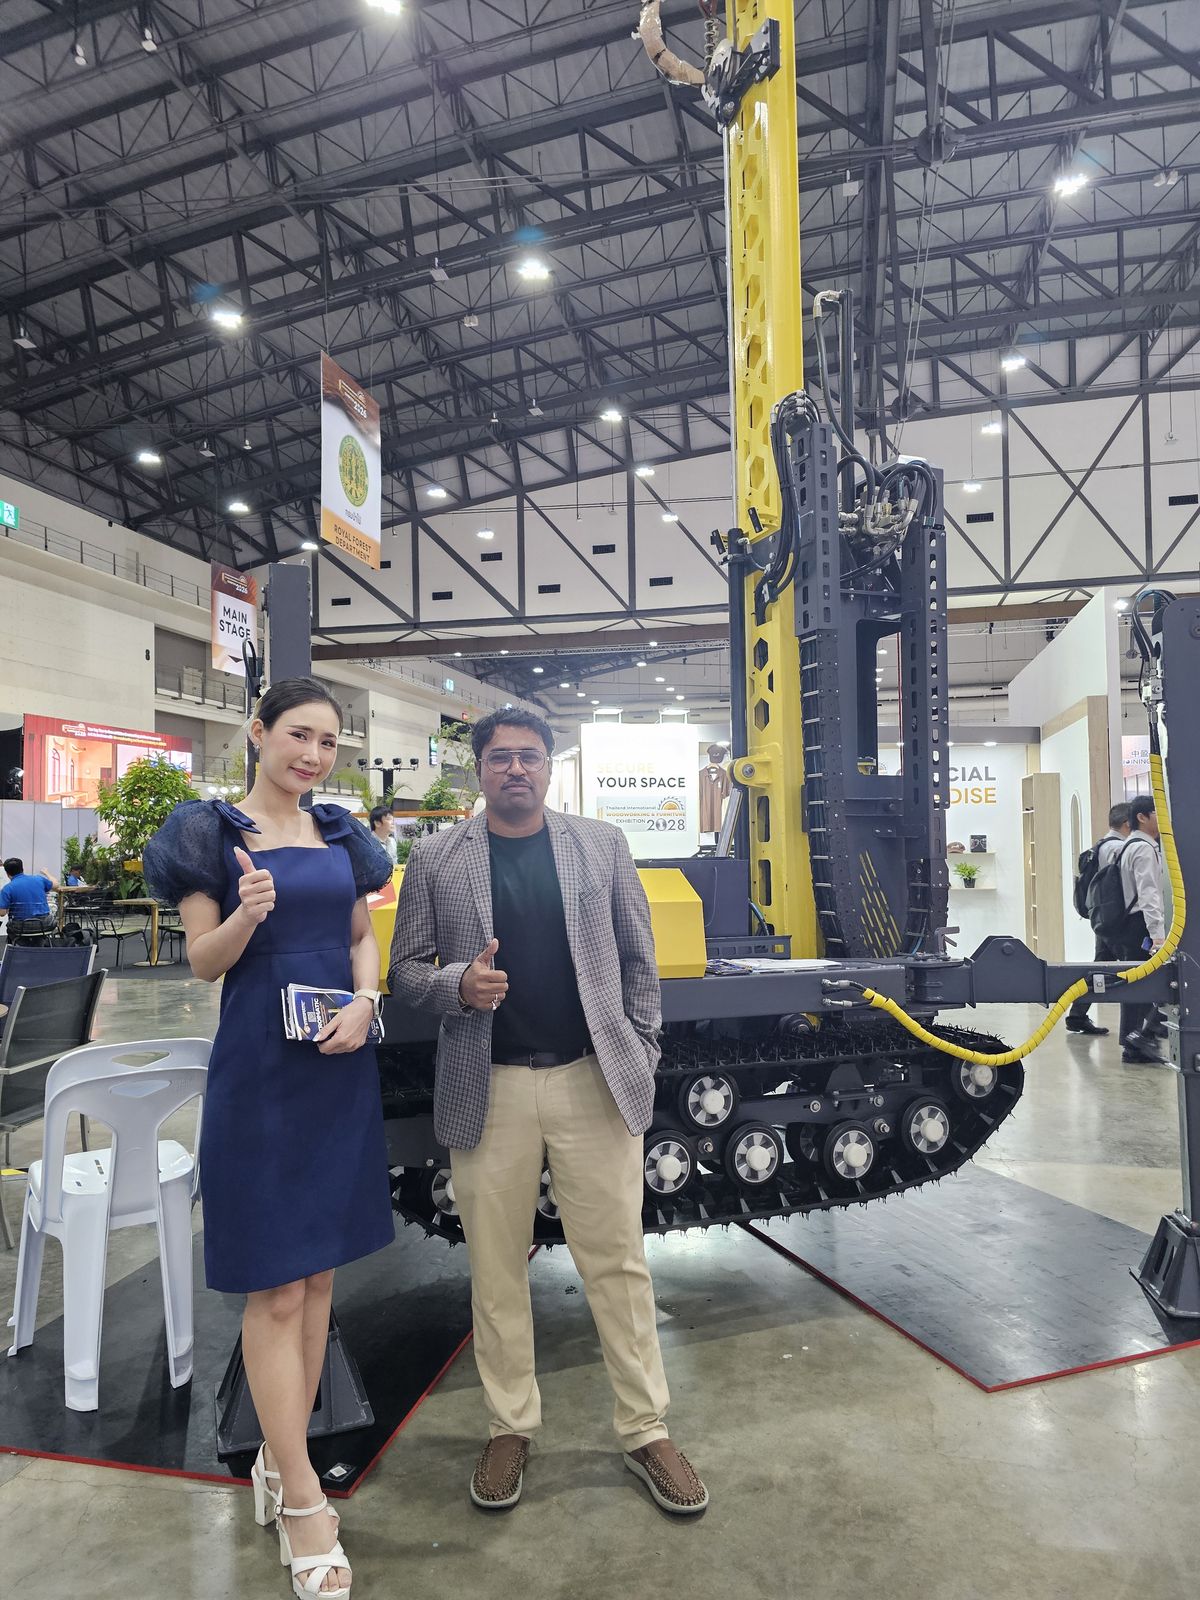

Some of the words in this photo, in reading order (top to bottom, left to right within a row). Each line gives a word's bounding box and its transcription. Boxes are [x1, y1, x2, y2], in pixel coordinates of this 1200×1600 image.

[333, 523, 352, 542] ROYAL
[352, 534, 372, 552] FOREST
[335, 537, 370, 562] DEPARTMENT
[223, 606, 247, 625] MAIN
[219, 620, 251, 639] STAGE
[597, 762, 655, 774] SECURE
[949, 766, 996, 782] CIAL
[597, 777, 637, 788] YOUR
[640, 777, 686, 788] SPACE
[950, 787, 996, 804] DISE
[646, 818, 685, 831] 2028
